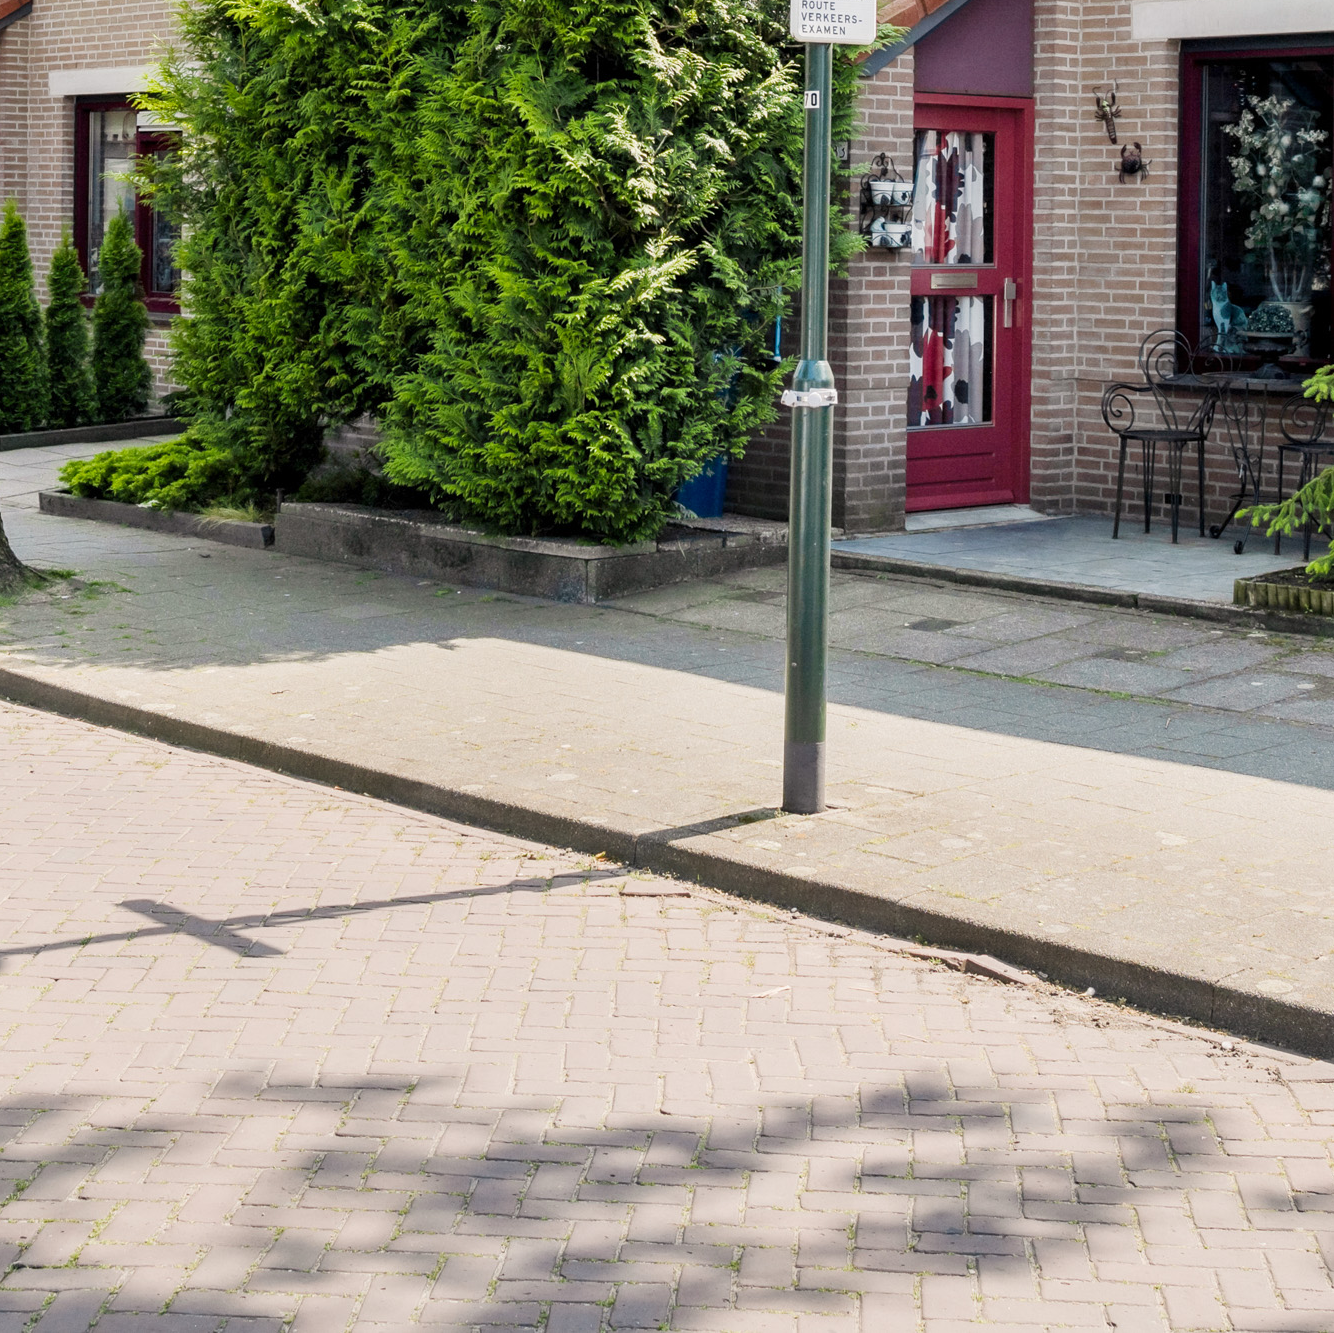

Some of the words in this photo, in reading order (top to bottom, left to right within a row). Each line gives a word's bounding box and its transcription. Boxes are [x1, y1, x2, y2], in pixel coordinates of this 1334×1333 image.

[801, 0, 836, 11] ROUTE
[800, 11, 863, 24] VERKEERS-
[801, 24, 846, 36] EXAMEN
